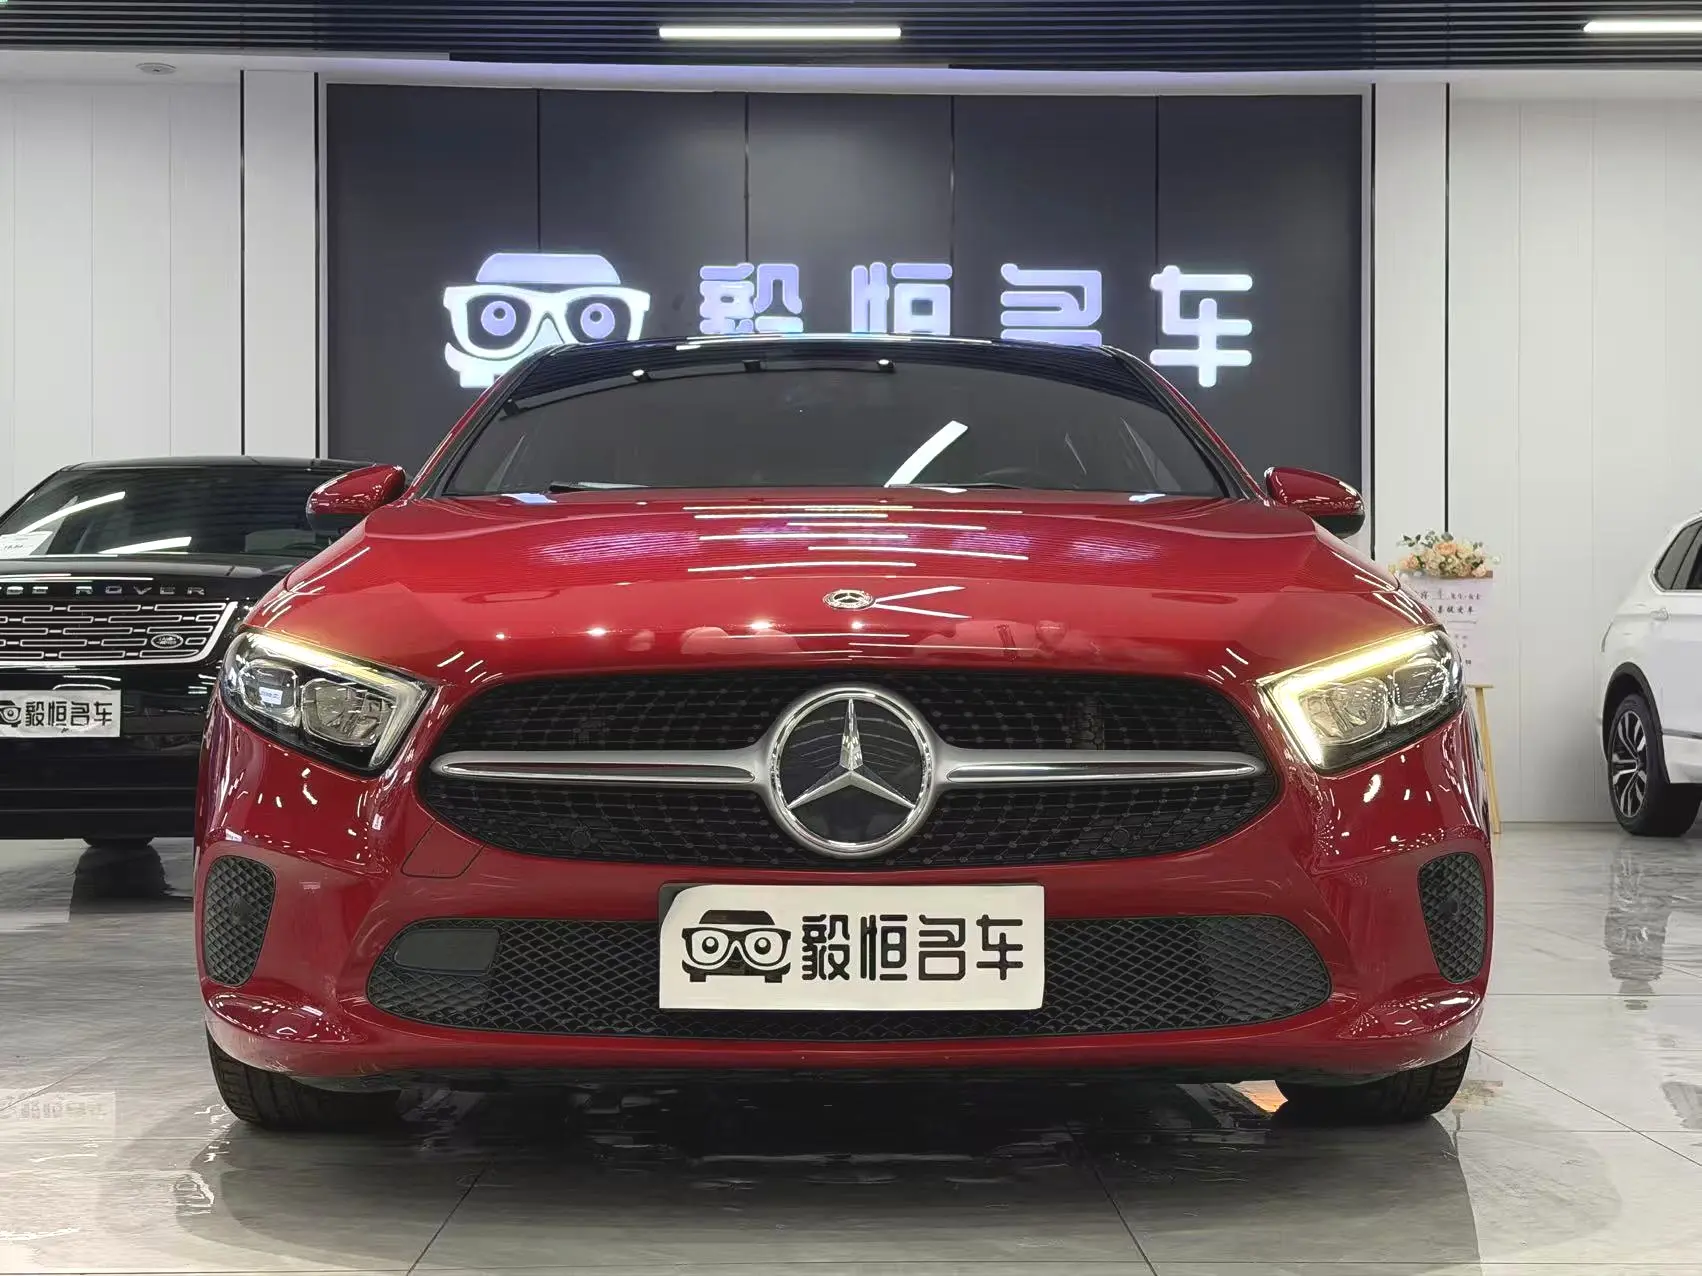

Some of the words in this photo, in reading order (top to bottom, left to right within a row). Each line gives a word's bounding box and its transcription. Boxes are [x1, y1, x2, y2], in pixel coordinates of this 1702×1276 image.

[700, 262, 1253, 388] 毅恒名车
[25, 701, 113, 727] 毅恒名车
[801, 914, 1024, 981] 毅恒名车
